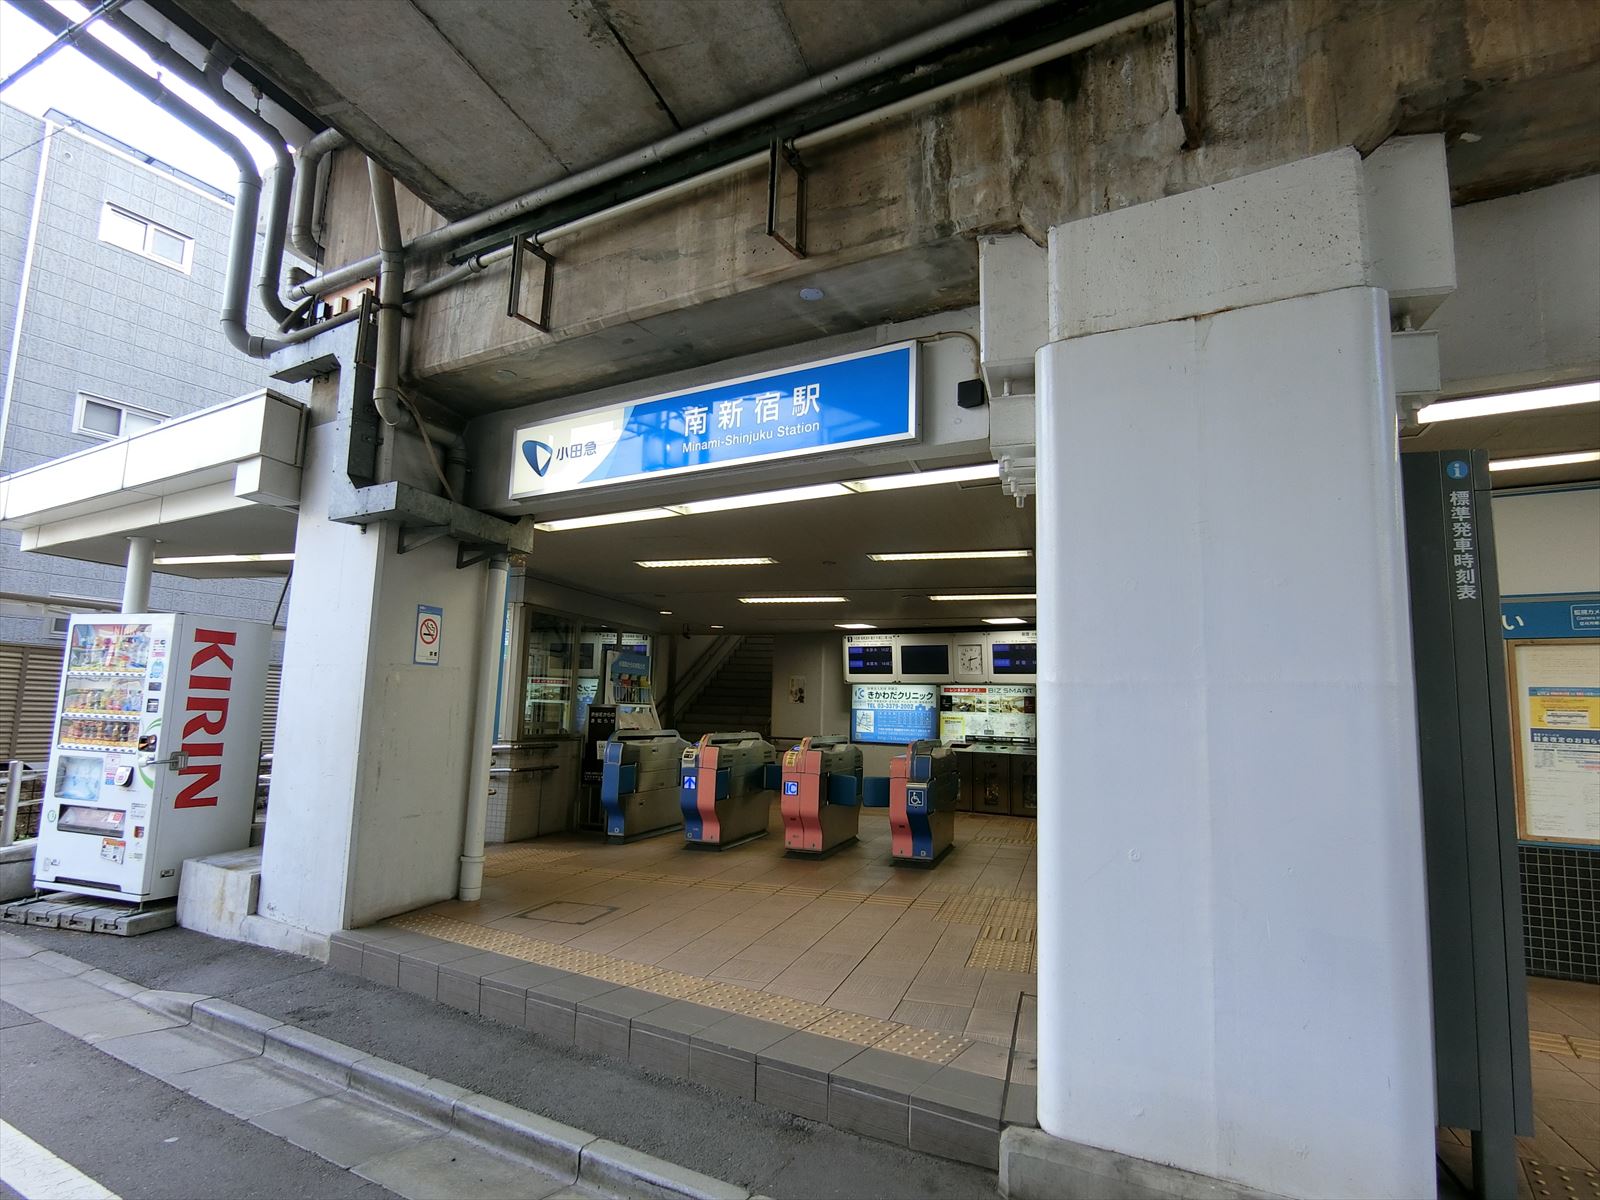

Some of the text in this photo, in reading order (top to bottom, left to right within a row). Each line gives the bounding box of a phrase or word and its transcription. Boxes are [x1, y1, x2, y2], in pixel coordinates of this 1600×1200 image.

[684, 383, 820, 436] 南新宿駅
[556, 441, 597, 460] 小田急
[682, 422, 820, 453] Minami-Shinjuku Station
[1449, 490, 1477, 600] 標準発車時刻表
[867, 691, 934, 700] きかわだクリニック
[174, 628, 237, 809] KIRIN
[786, 783, 797, 794] IC
